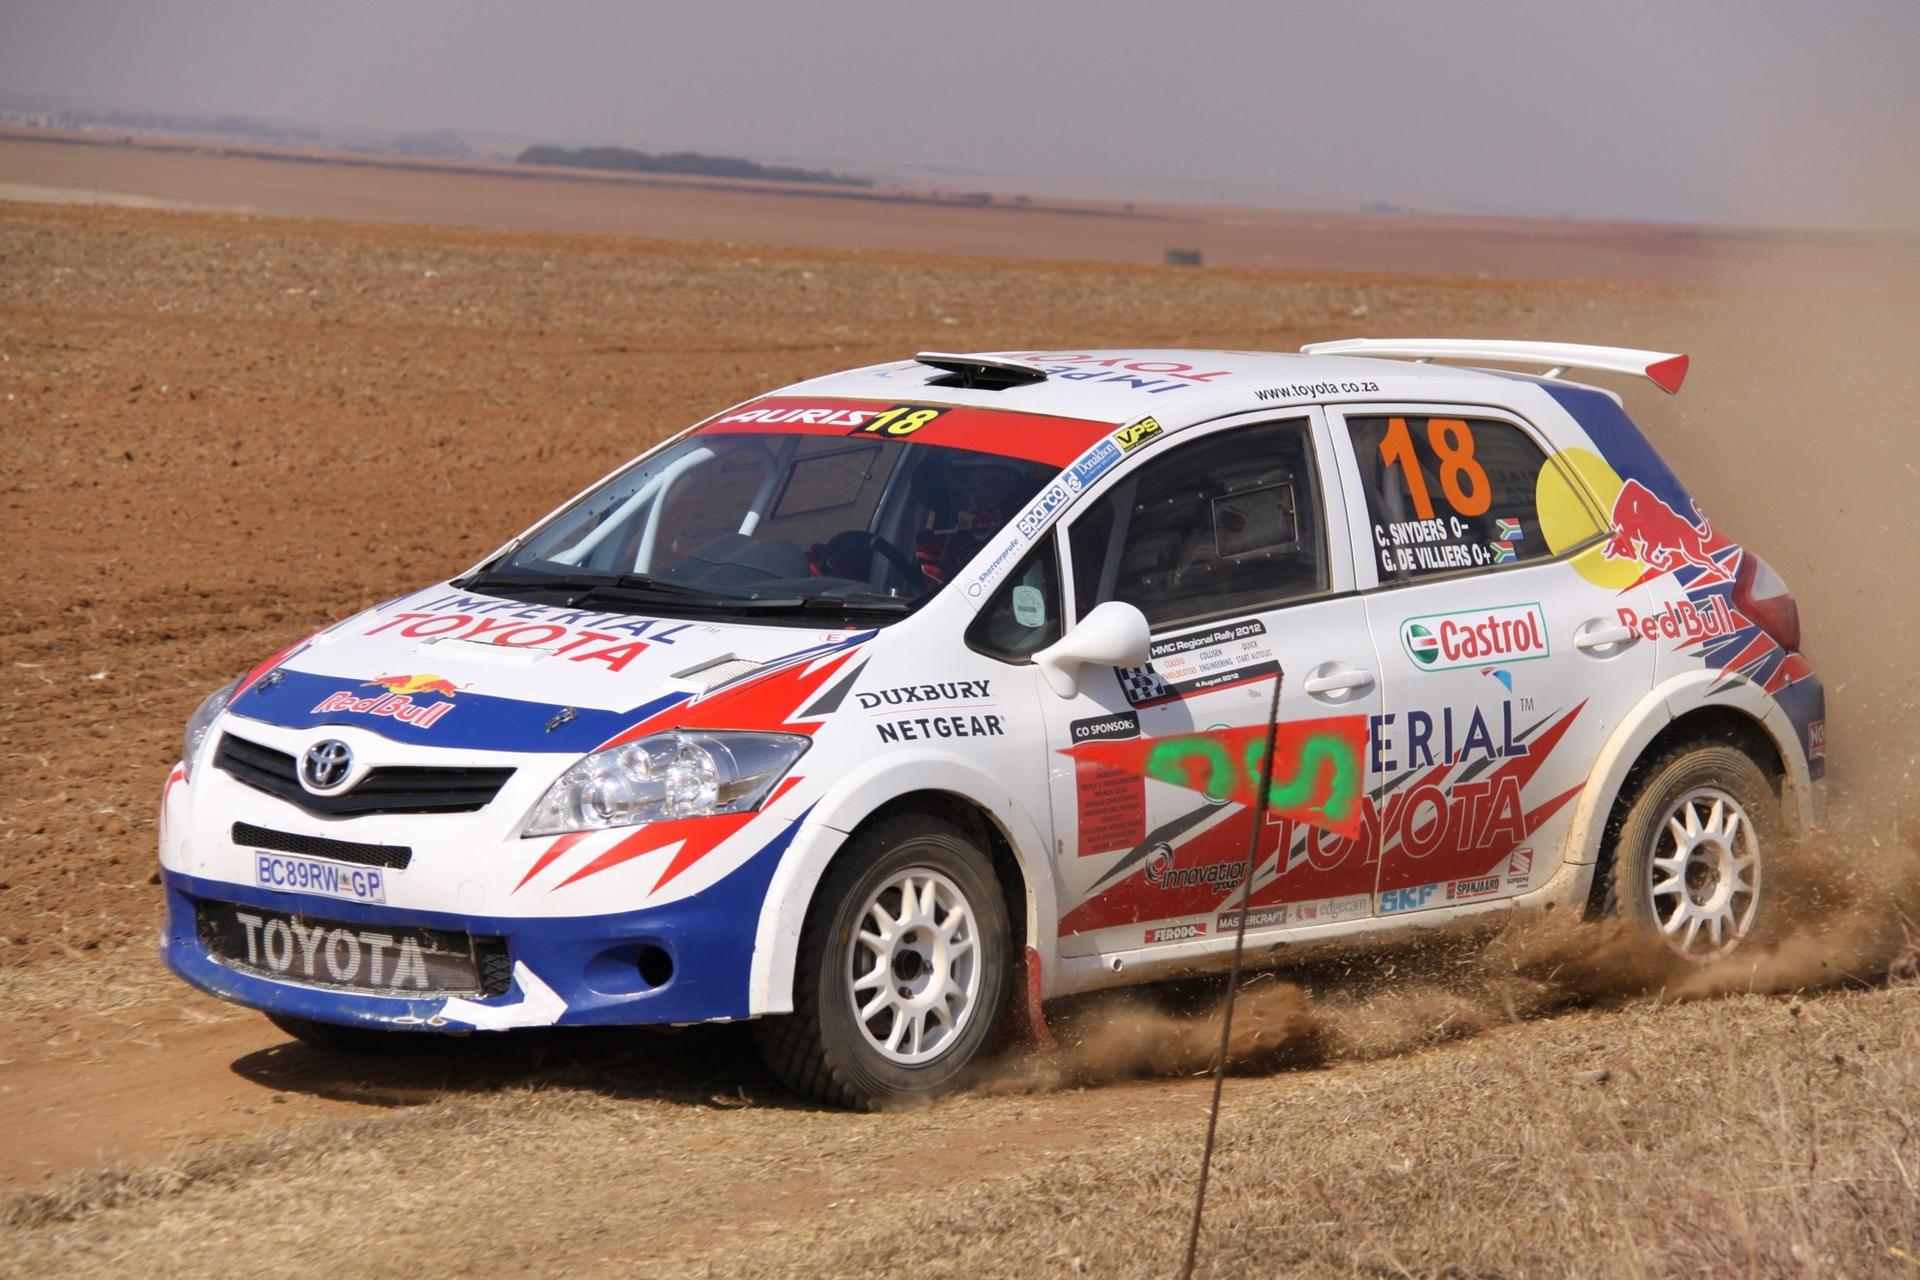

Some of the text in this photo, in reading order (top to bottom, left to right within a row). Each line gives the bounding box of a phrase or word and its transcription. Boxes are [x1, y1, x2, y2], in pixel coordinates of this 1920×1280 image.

[717, 408, 880, 426] AURIS
[864, 406, 939, 435] 18
[1117, 417, 1159, 446] VPS
[1078, 443, 1115, 476] Donaldson
[1379, 418, 1493, 519] 18
[1019, 486, 1066, 535] sparco
[1375, 524, 1391, 547] C.
[1389, 518, 1447, 545] SNYDERS
[1382, 549, 1397, 572] G.
[1397, 547, 1417, 571] DE
[1415, 544, 1472, 569] VILLIERS
[413, 595, 695, 645] IMPERIAL
[364, 612, 651, 672] TOYOTA
[1152, 622, 1262, 656] HMC Regional Rally 2012
[1441, 611, 1543, 662] Castrol
[1199, 658, 1233, 672] ENGINEERING
[856, 680, 990, 709] DUXBURY
[1076, 719, 1135, 737] CO SPONSORS
[259, 856, 380, 897] BC89RW GP
[1380, 885, 1438, 913] SKF
[1155, 926, 1196, 941] FERODO
[1220, 911, 1285, 929] MASERCRAFT
[237, 913, 430, 988] TOYOTA
